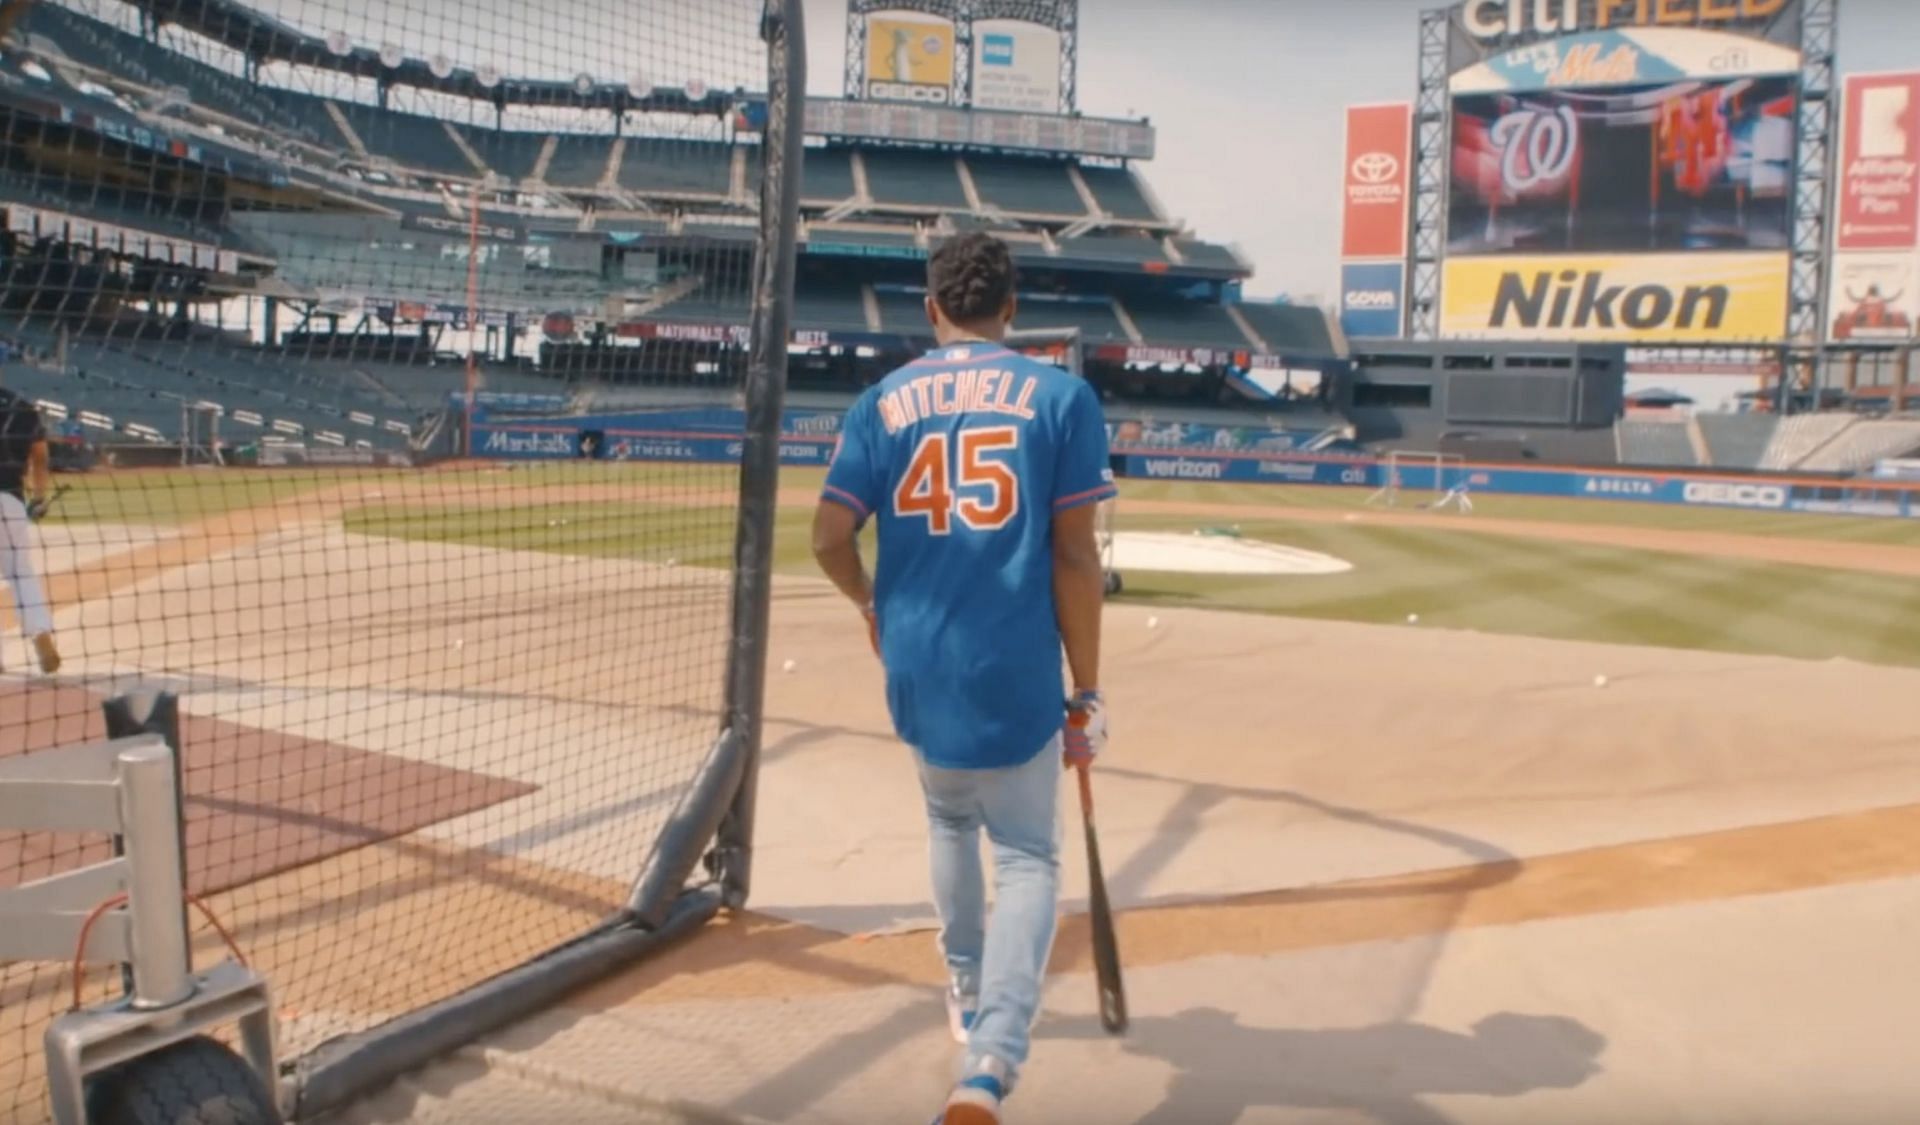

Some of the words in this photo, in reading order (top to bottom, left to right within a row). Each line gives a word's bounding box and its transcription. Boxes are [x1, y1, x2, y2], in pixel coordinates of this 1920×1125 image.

[1708, 52, 1748, 71] citi
[870, 82, 947, 103] GEICO
[1348, 184, 1401, 197] TOYOTA
[1850, 178, 1911, 196] Health
[1859, 197, 1899, 214] Plan
[1488, 266, 1730, 330] Nikon
[877, 369, 1038, 434] MITCHELL
[485, 430, 571, 454] Marshalls
[1145, 456, 1221, 478] verizon
[893, 425, 1018, 536] 45
[1601, 478, 1652, 494] DELTA
[1683, 481, 1785, 507] GEICO
